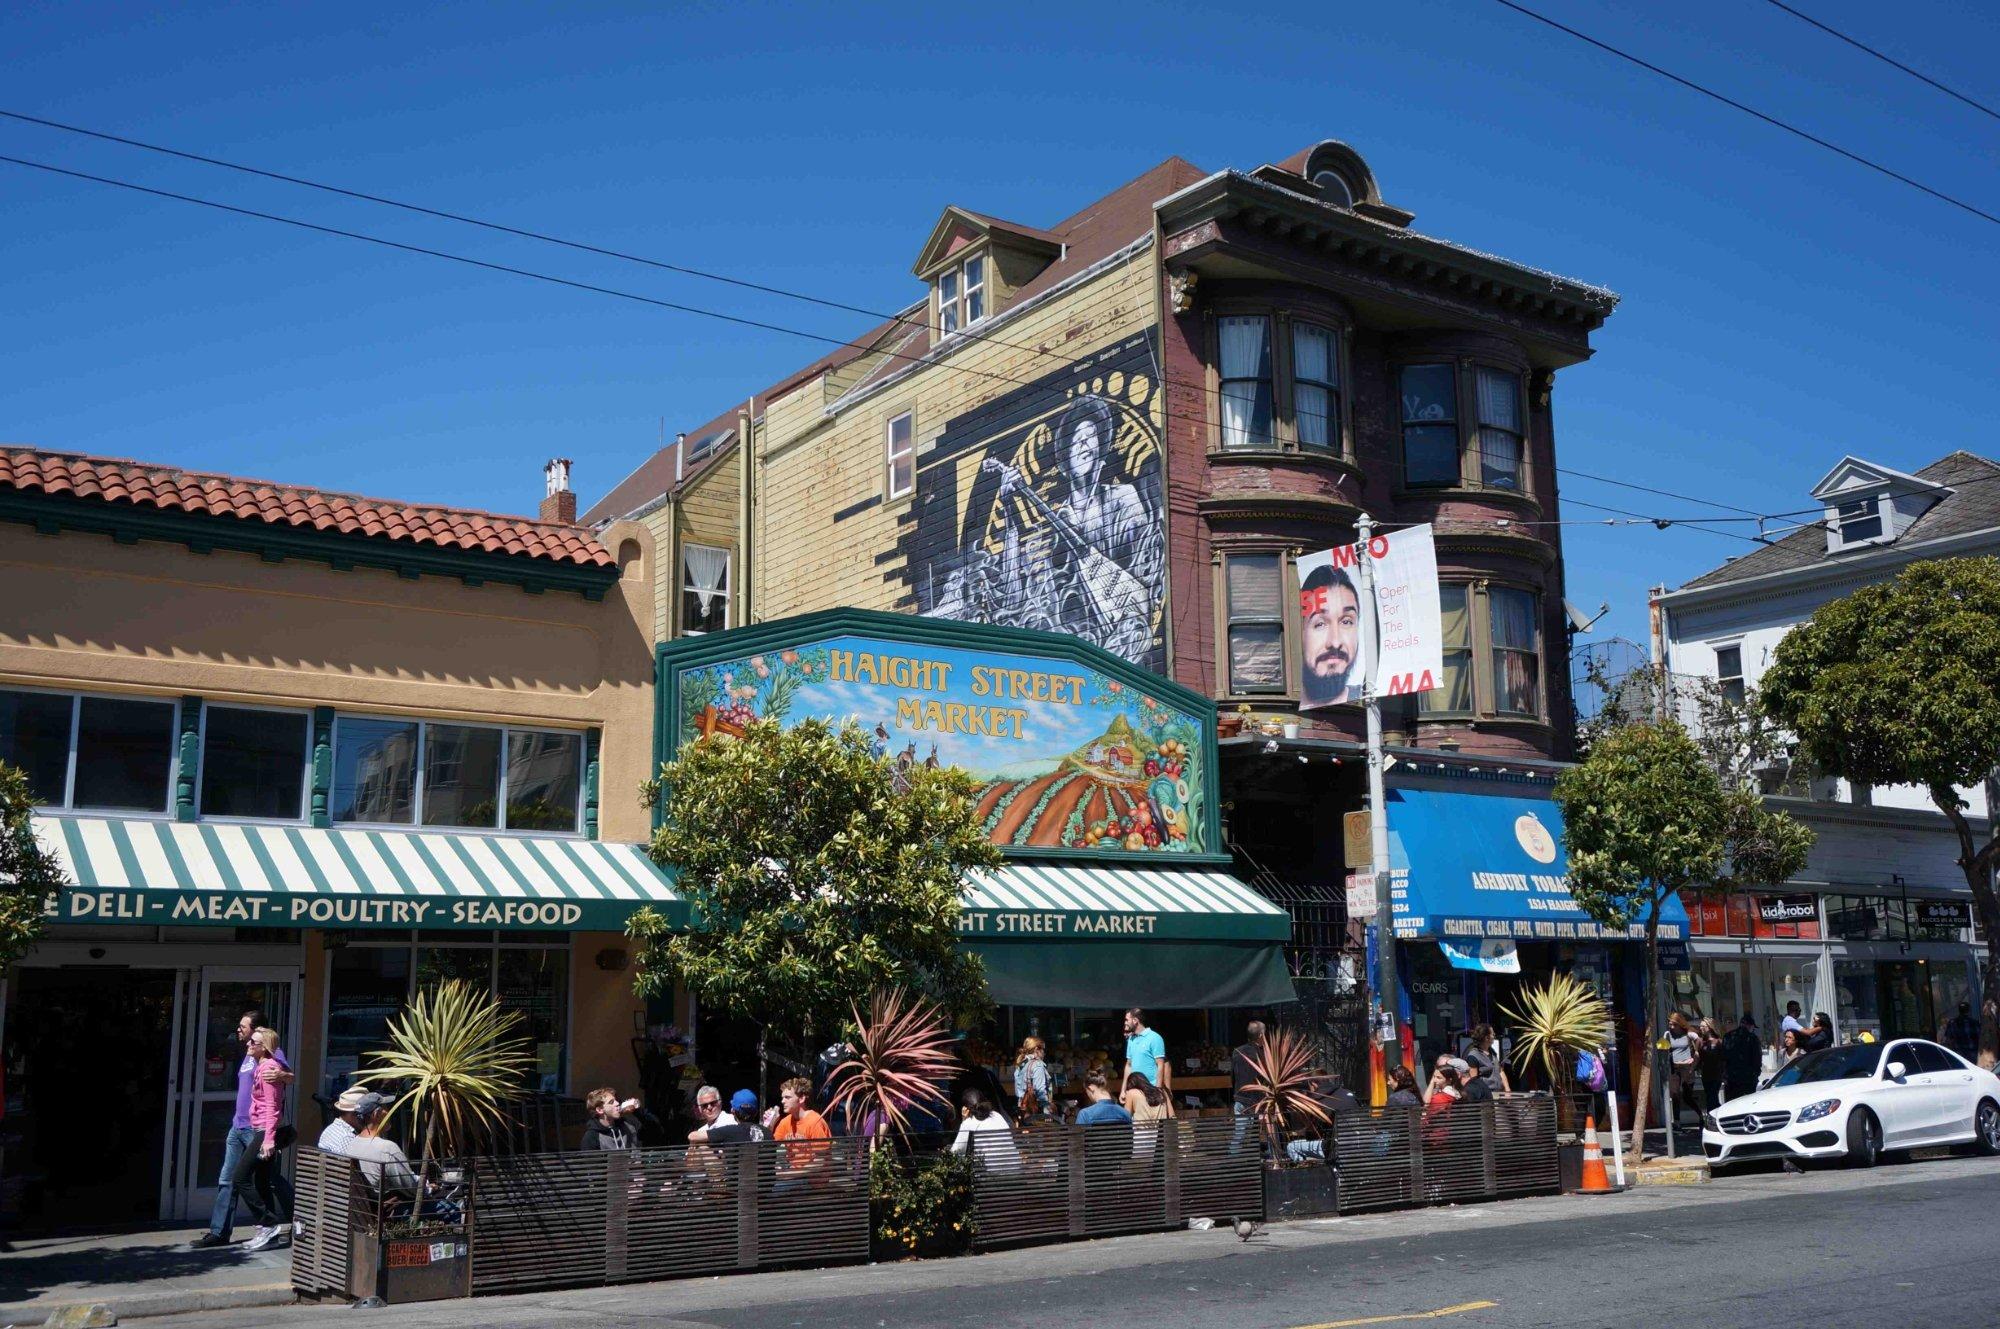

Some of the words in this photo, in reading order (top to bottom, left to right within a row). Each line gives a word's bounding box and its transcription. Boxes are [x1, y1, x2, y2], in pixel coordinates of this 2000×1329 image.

[1379, 584, 1408, 600] Open
[1383, 605, 1399, 616] For
[1384, 622, 1404, 634] The
[1384, 634, 1420, 651] Rebels
[830, 649, 953, 692] HAIGHT
[971, 665, 1086, 706] STREET
[1388, 670, 1435, 696] MA
[895, 697, 1029, 740] MARKET
[1472, 872, 1530, 891] ASHBURY
[70, 892, 144, 917] DELI
[172, 895, 267, 920] MEAT
[290, 898, 430, 923] POULTRY
[452, 901, 582, 925] SEAFOOD
[996, 913, 1066, 933] STREET
[1073, 915, 1157, 934] MARKET
[1412, 982, 1449, 994] CIGARS
